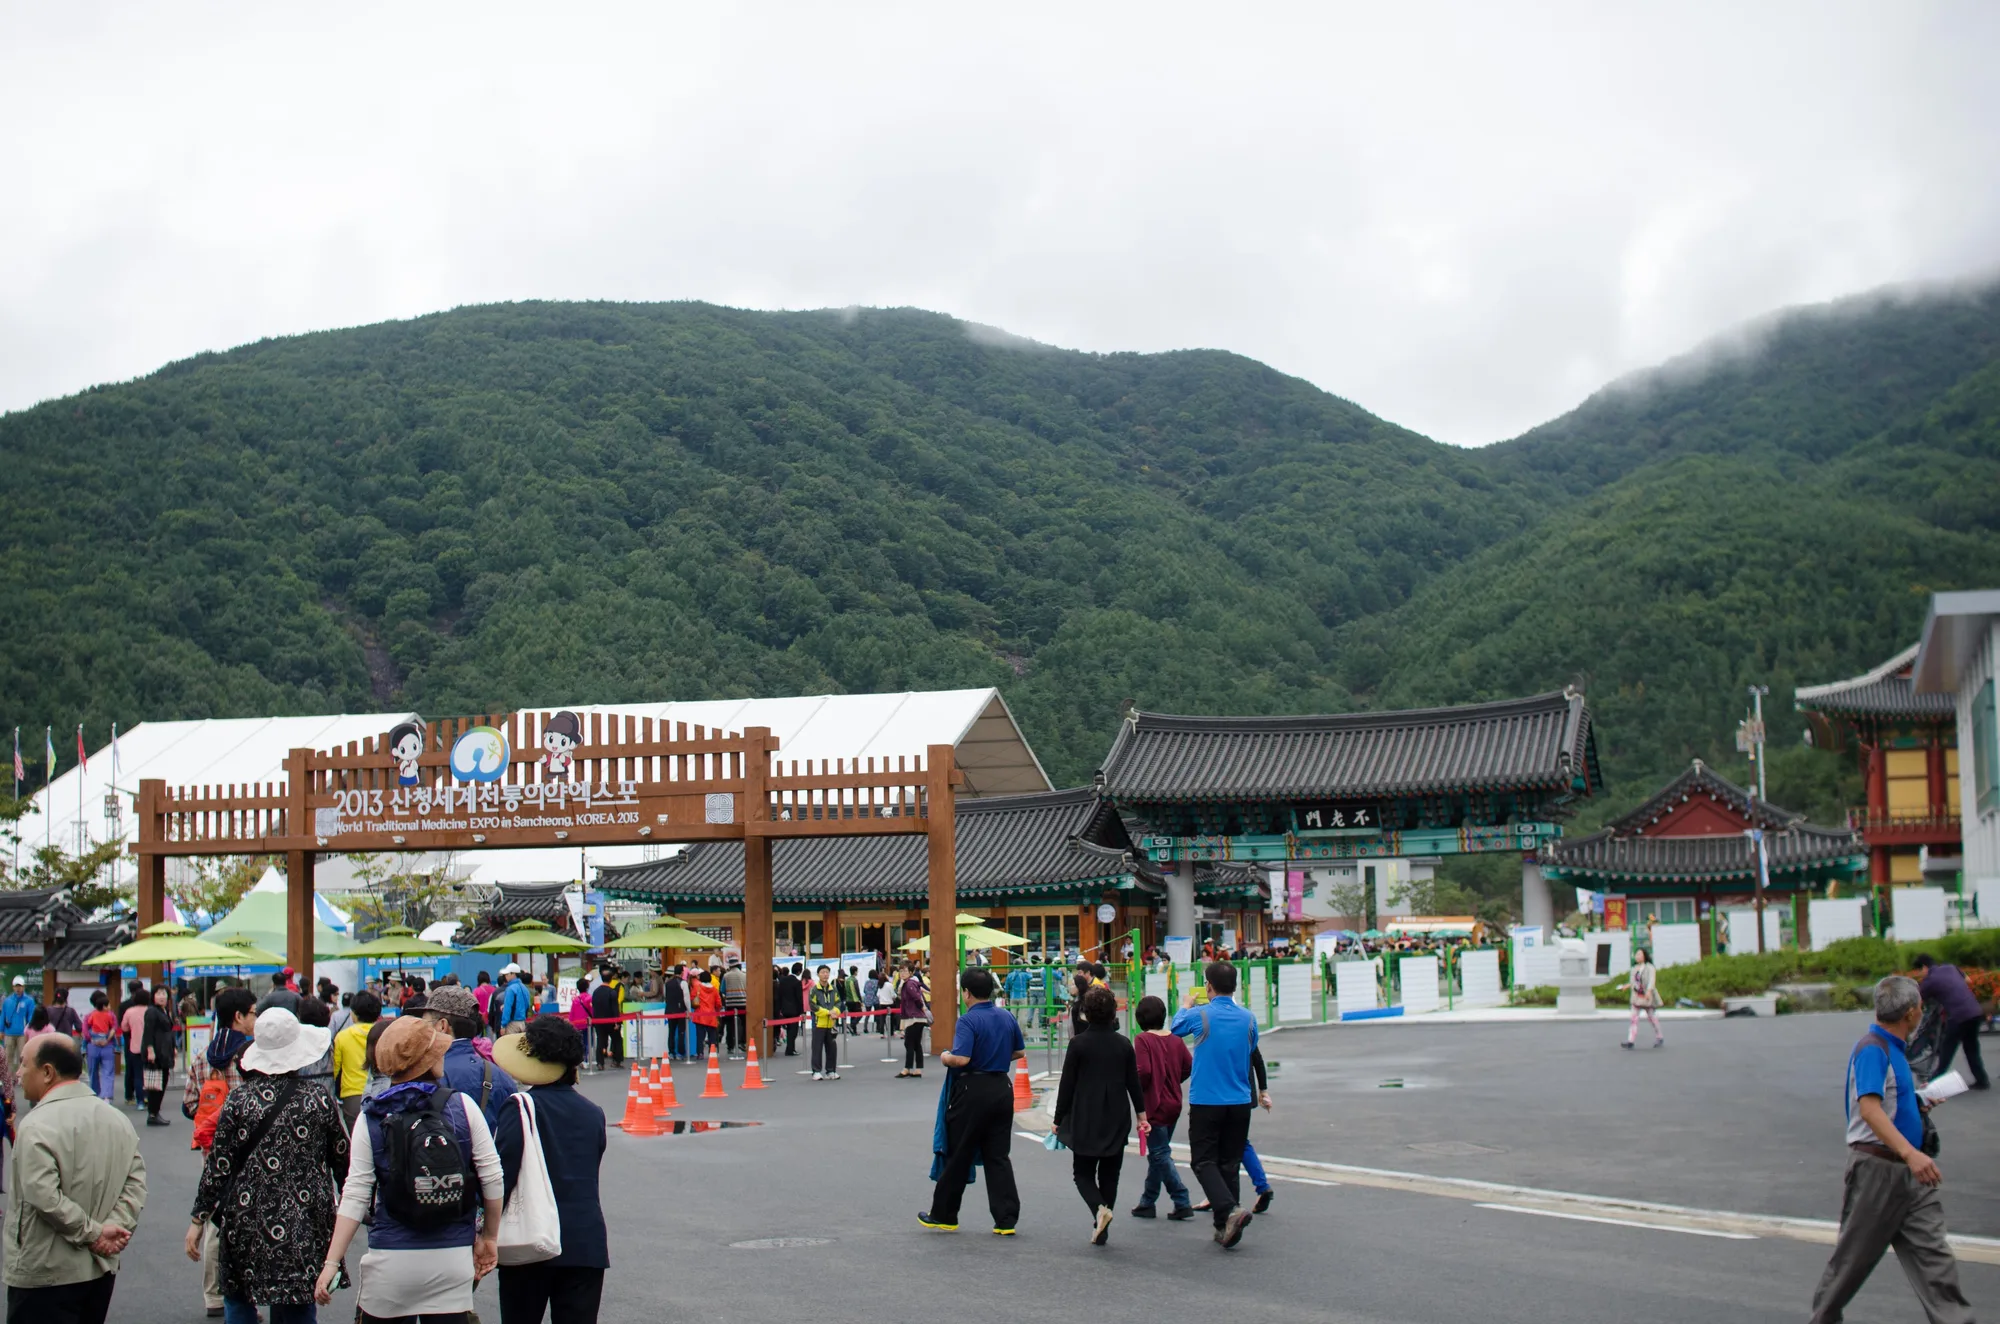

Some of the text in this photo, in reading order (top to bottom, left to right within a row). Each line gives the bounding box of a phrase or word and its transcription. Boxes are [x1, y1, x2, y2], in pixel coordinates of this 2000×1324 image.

[333, 780, 640, 817] 2013 산청세계전통의약엑스포
[333, 811, 639, 834] World Traditional Medicine EXPO in Sancheong, KOREA 2013
